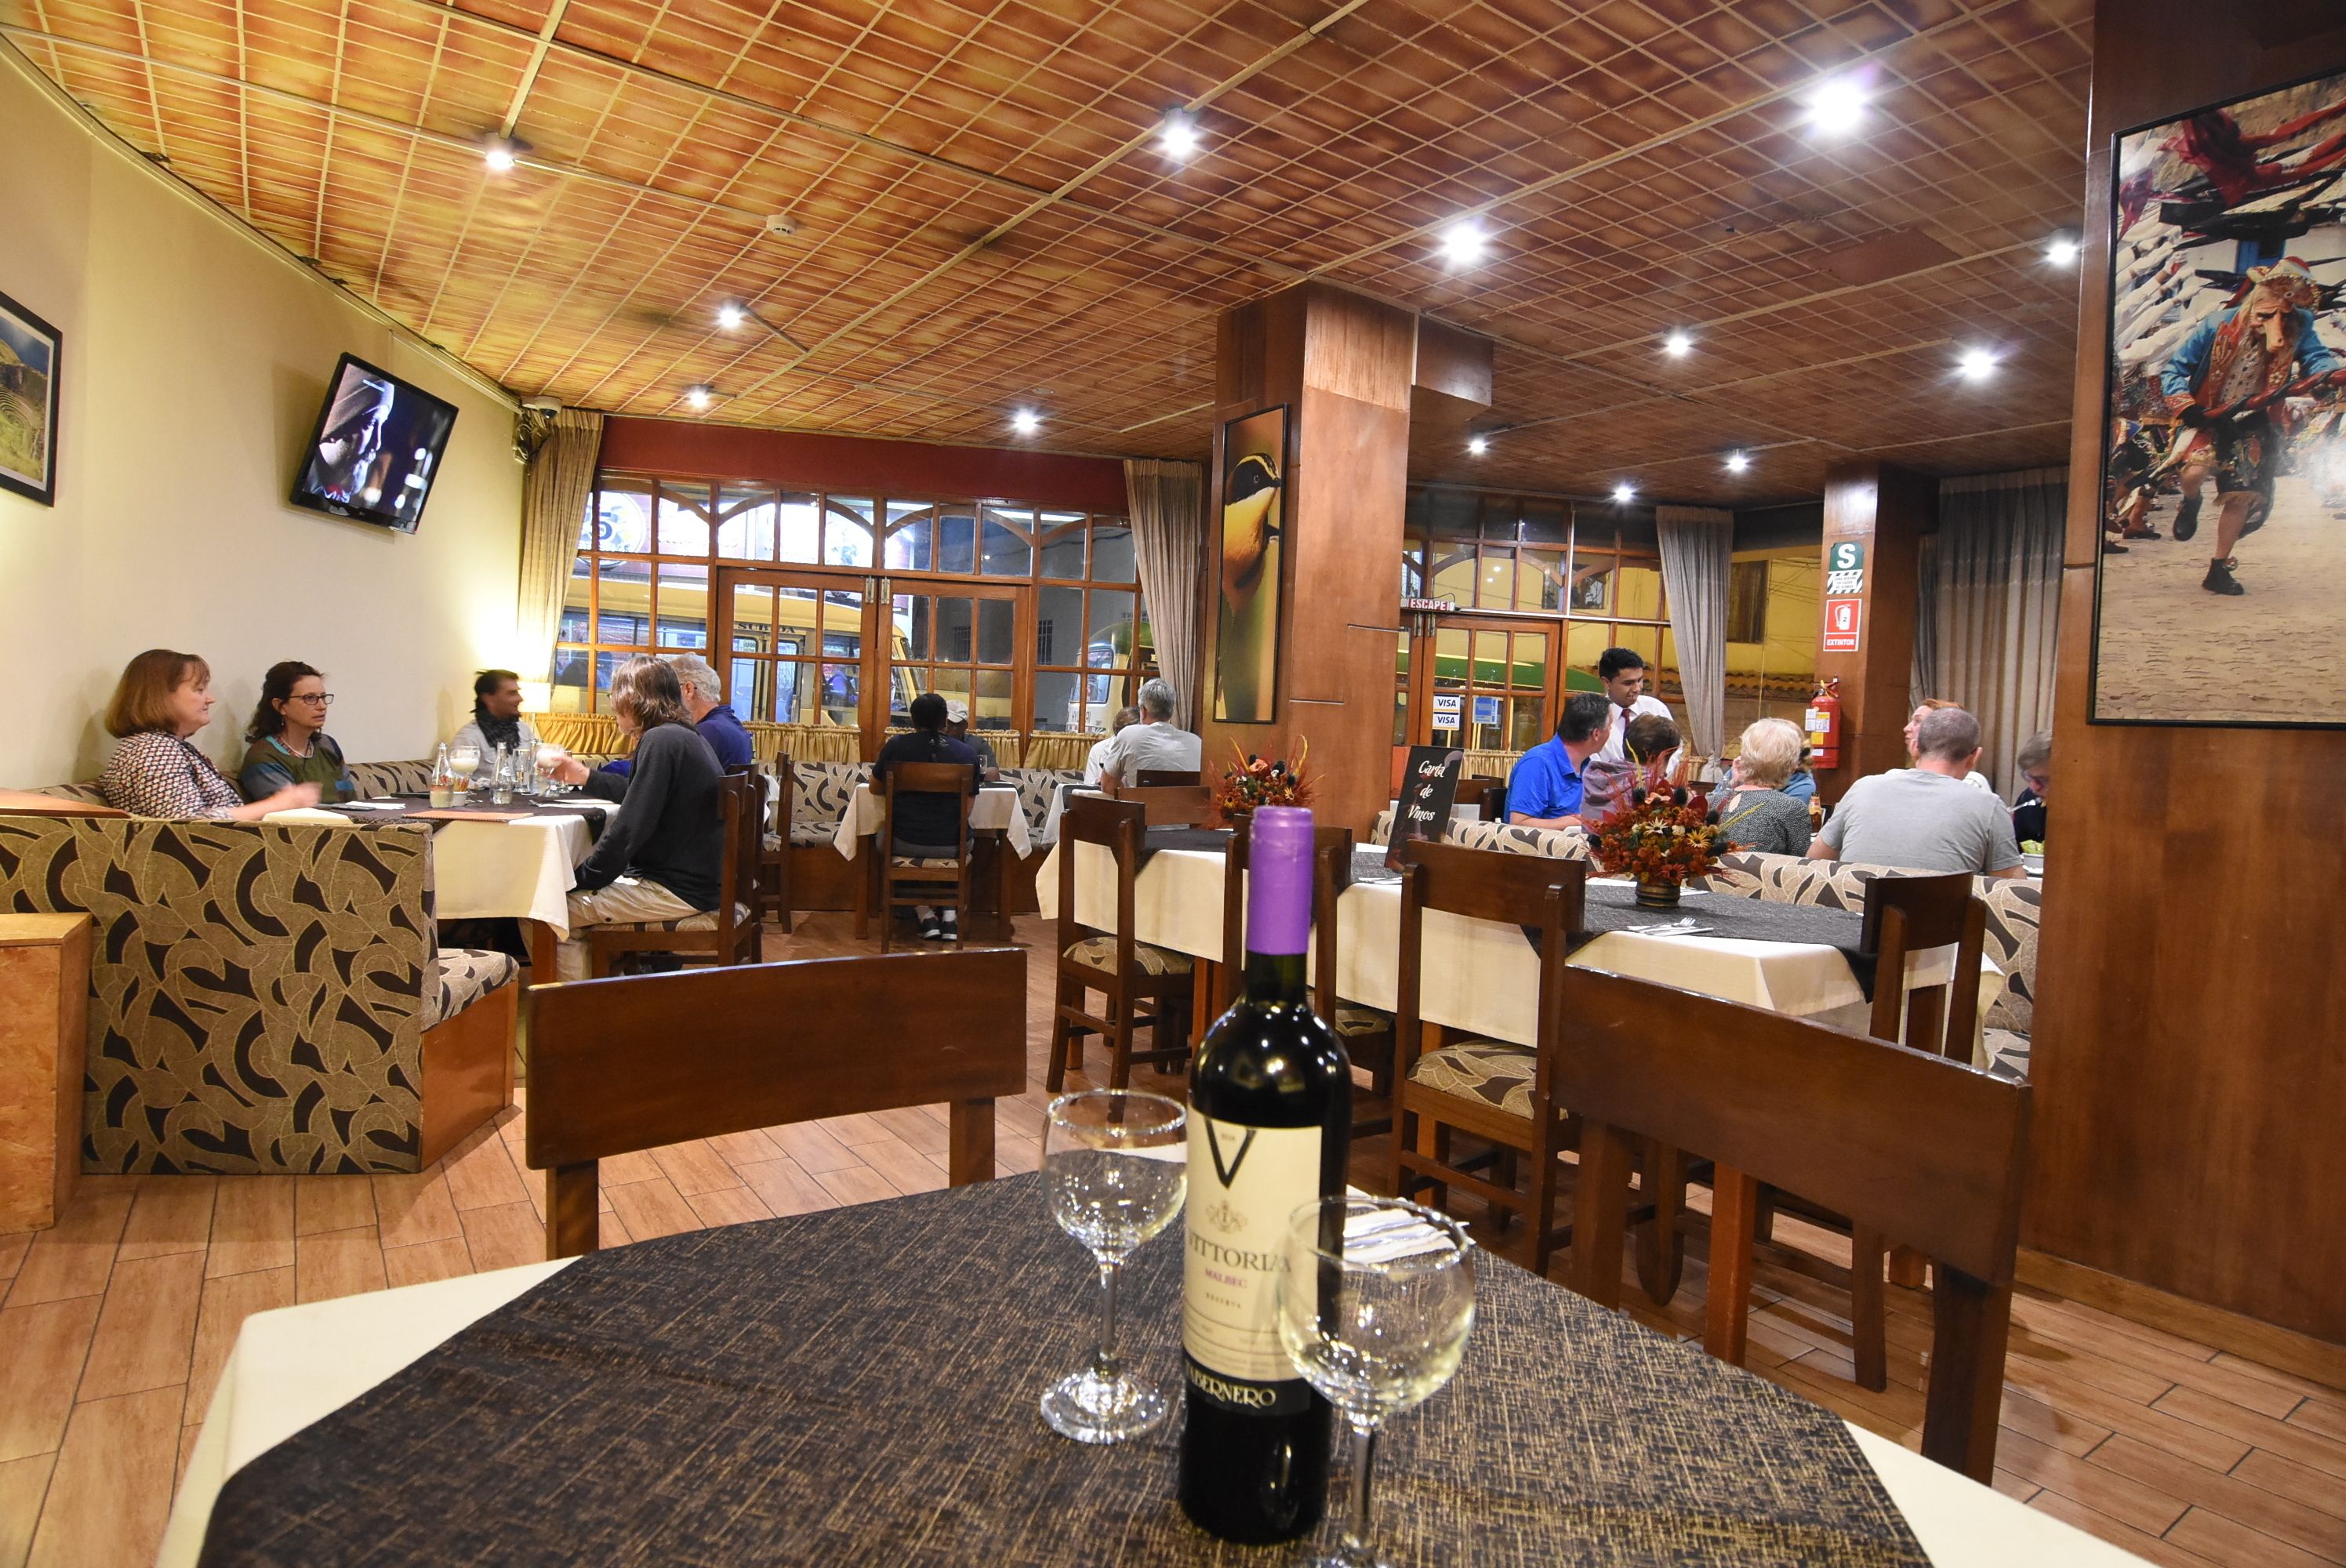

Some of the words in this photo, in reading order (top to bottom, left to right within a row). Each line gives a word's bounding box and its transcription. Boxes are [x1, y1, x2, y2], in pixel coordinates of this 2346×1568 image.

[1836, 543, 1856, 569] S
[1411, 598, 1446, 611] ESCAPE
[739, 622, 795, 633] SUBDA
[1418, 760, 1445, 778] Carta
[1419, 784, 1433, 799] de
[1408, 804, 1436, 822] Vinos
[1204, 1116, 1257, 1189] V
